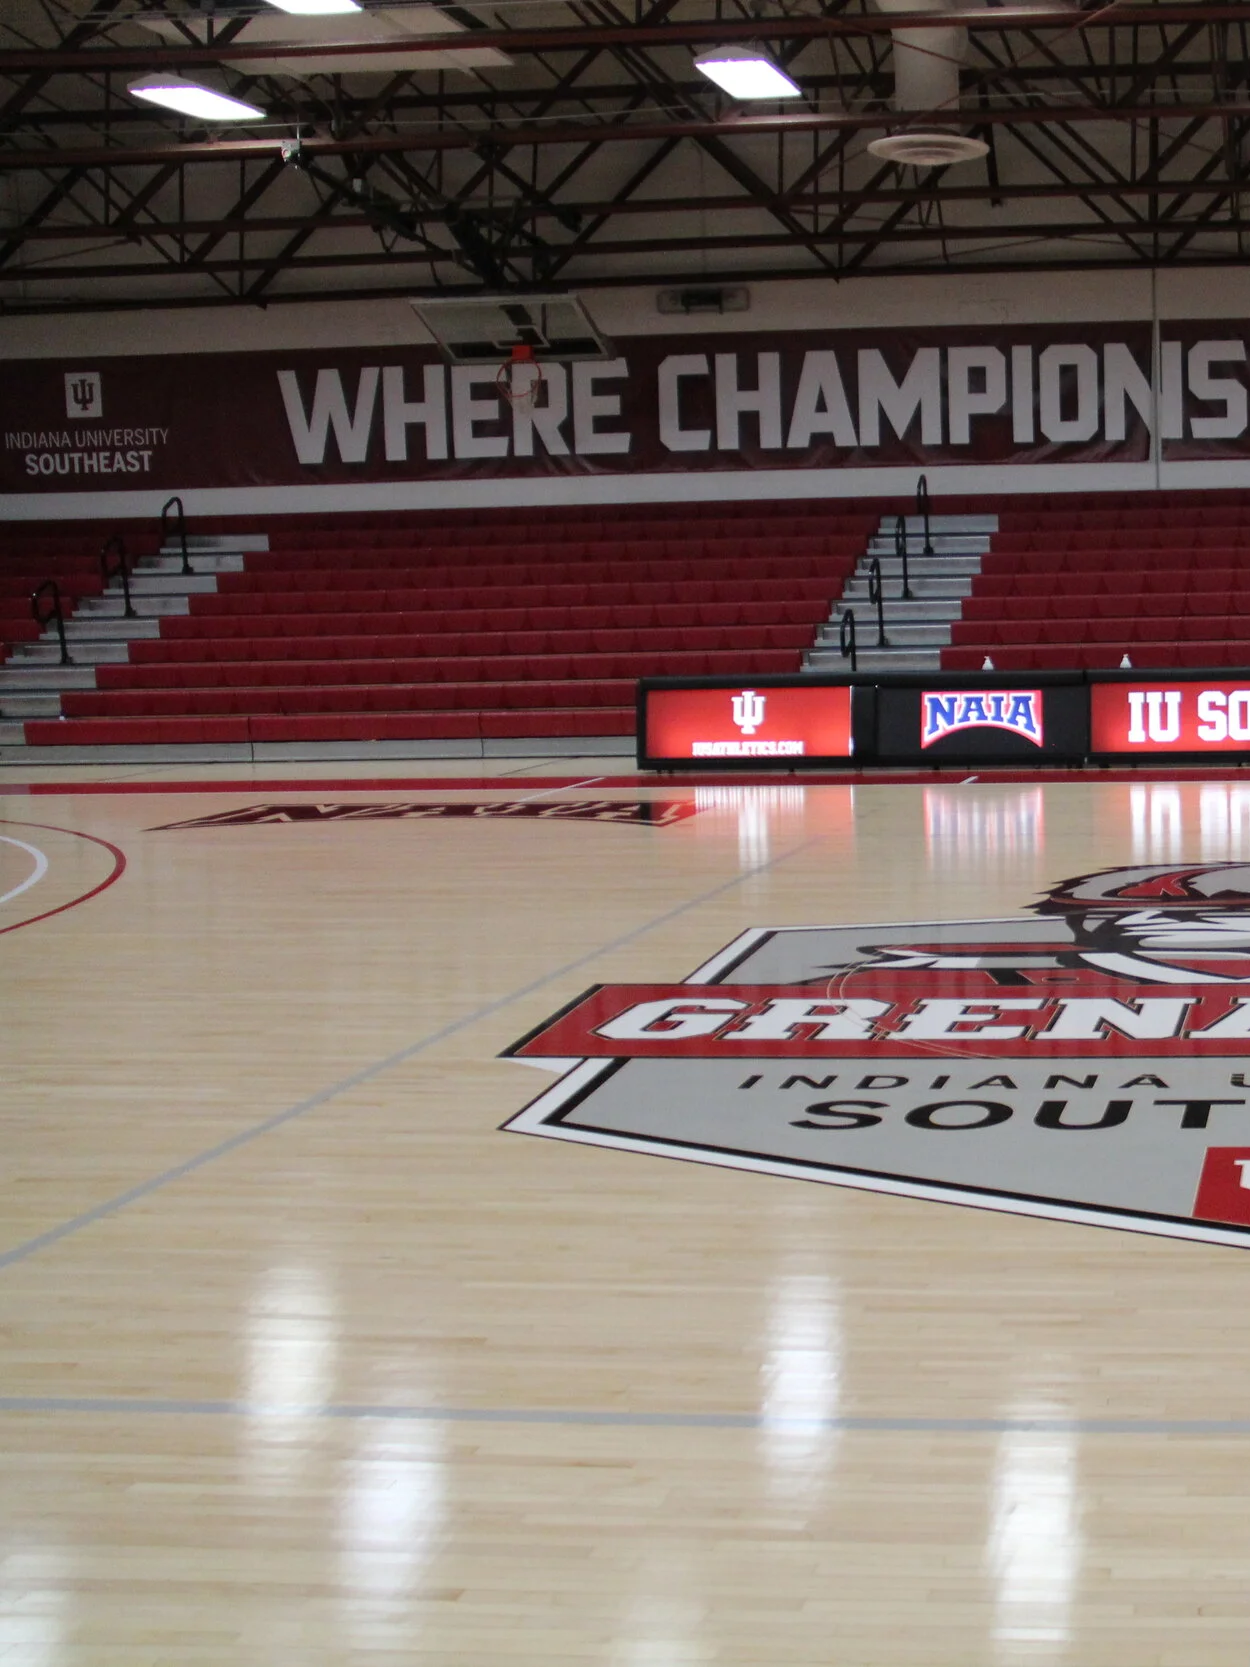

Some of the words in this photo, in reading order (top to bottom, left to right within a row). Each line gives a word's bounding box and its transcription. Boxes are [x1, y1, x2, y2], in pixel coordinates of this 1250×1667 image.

[277, 356, 631, 464] WHERE
[657, 340, 1248, 452] CHAMPIONS
[5, 431, 72, 449] INDIANA
[75, 428, 169, 447] UNIVERSITY
[25, 450, 153, 475] SOUTHEAST
[926, 695, 1038, 733] NAIA
[1127, 691, 1182, 743] IU
[738, 1073, 1171, 1090] INDIANA
